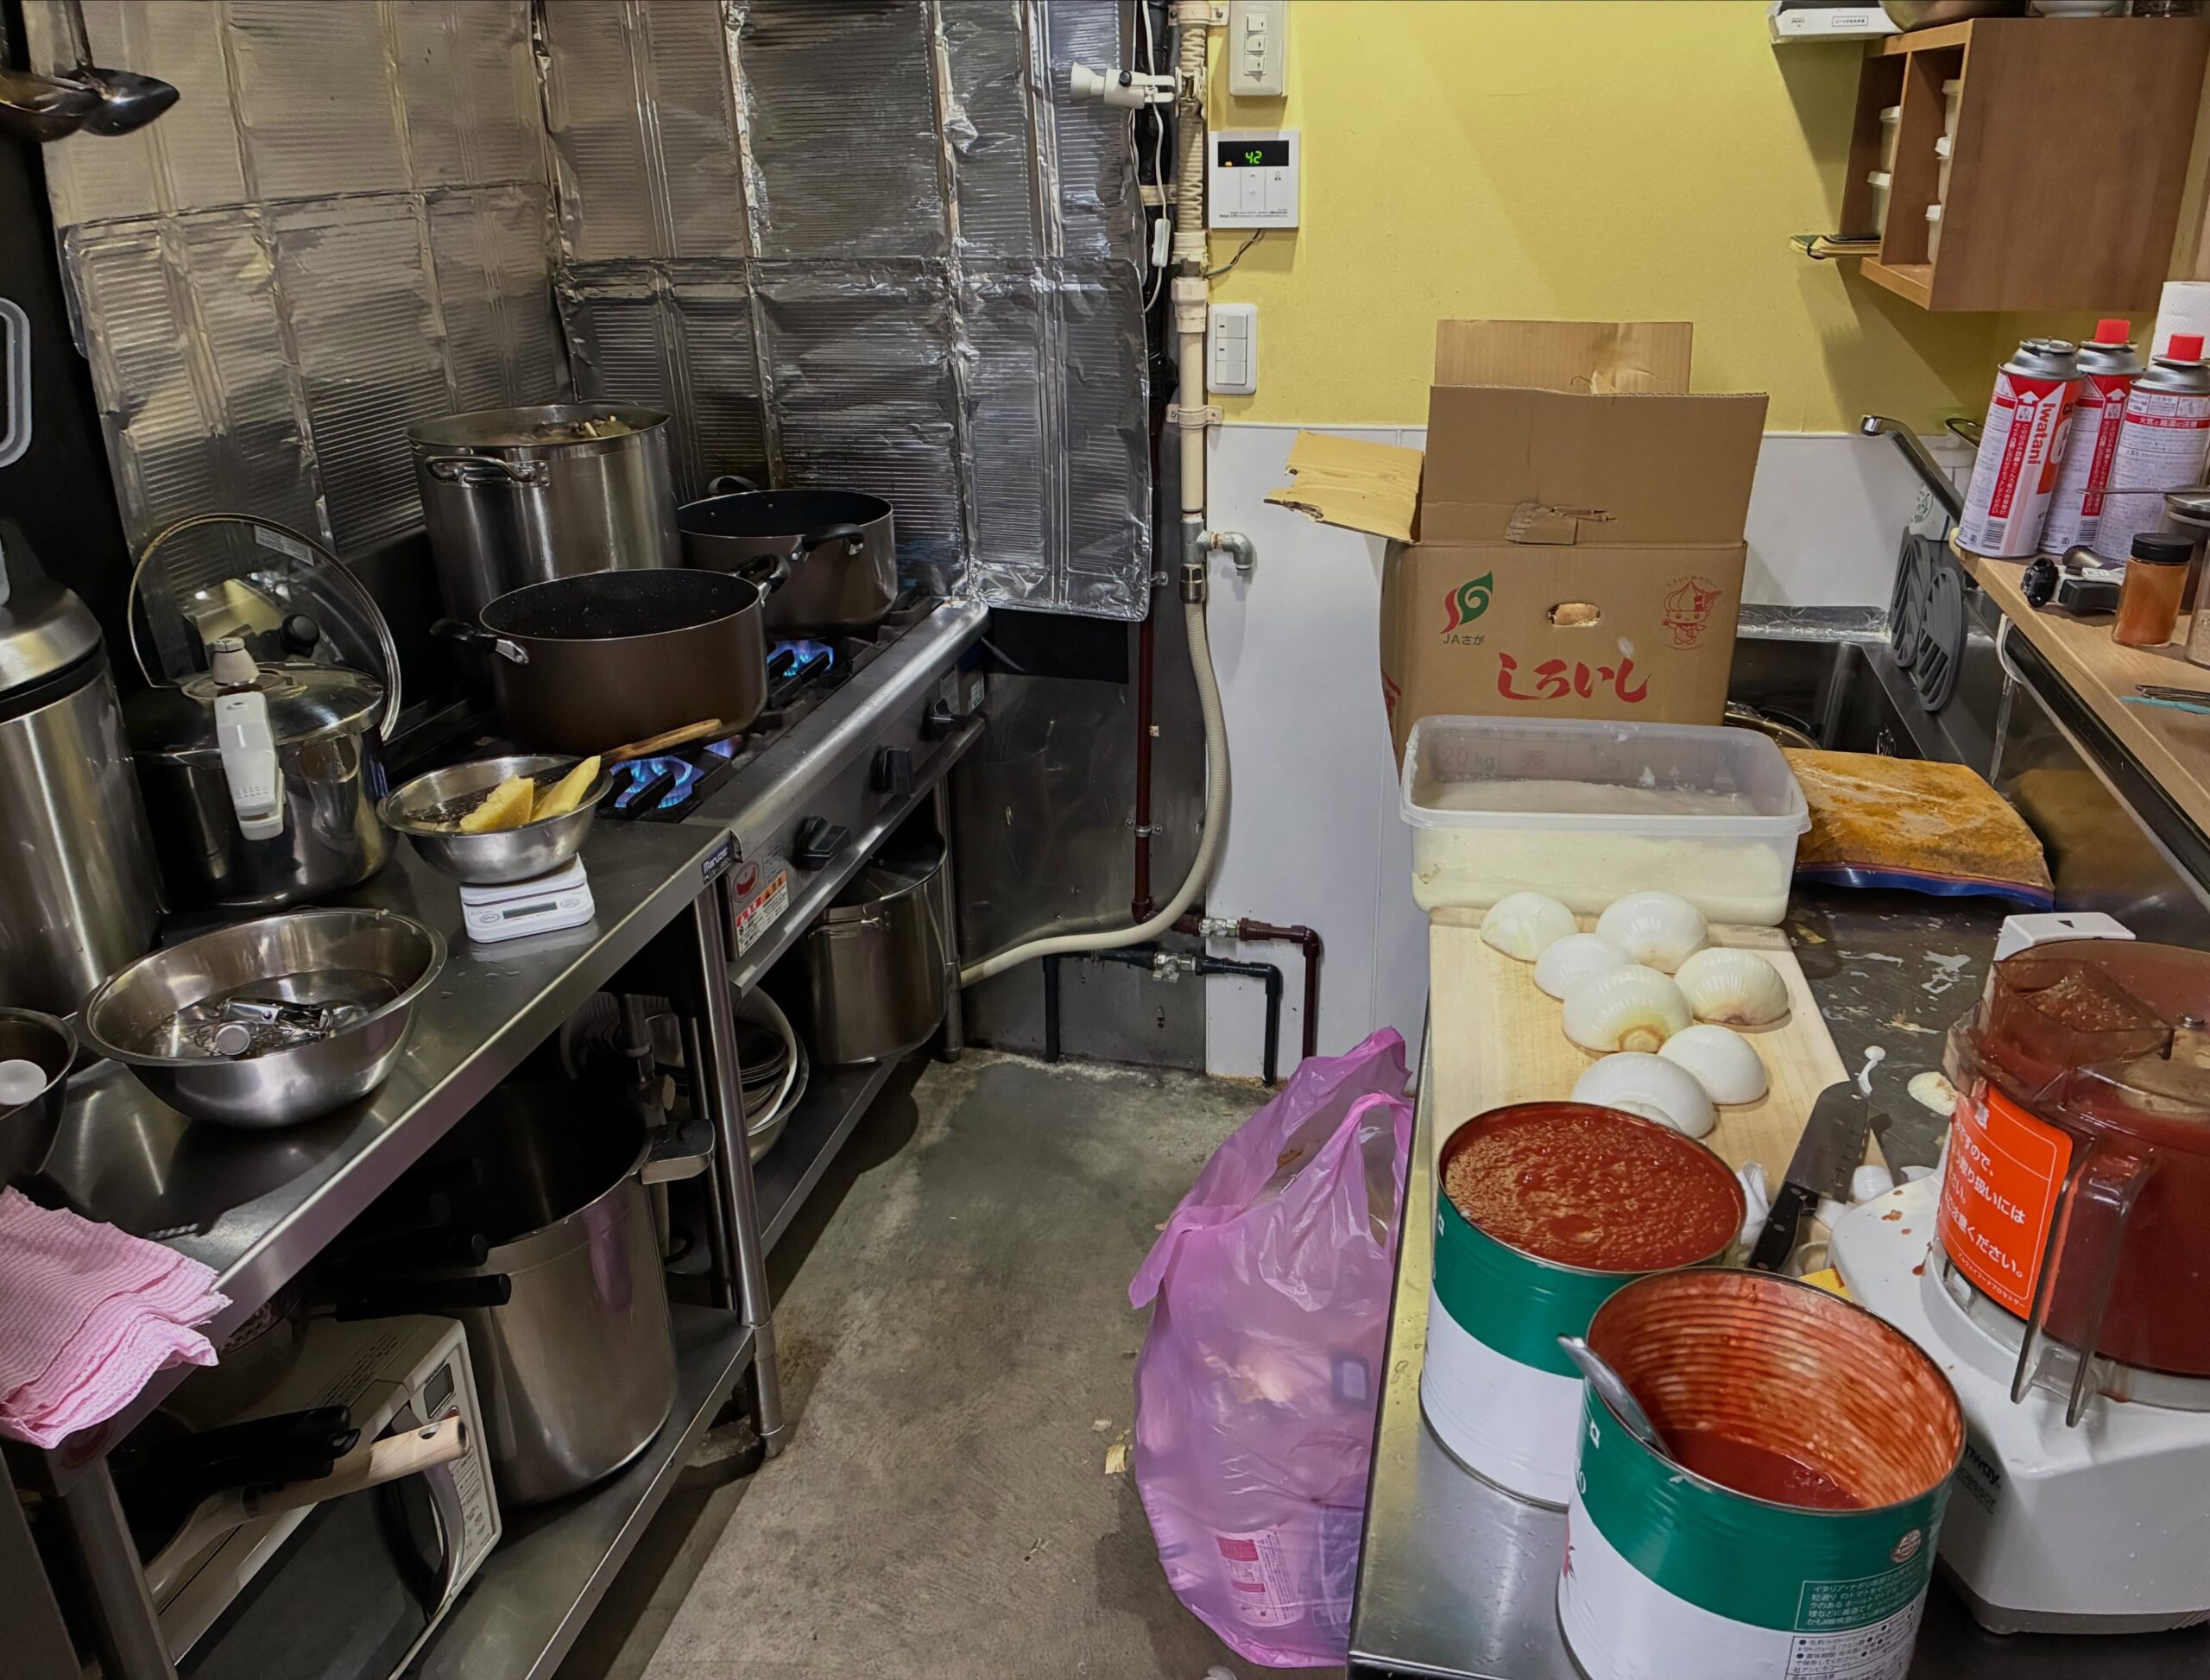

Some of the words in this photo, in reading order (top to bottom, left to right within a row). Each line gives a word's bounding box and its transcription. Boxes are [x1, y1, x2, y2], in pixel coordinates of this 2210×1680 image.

[1245, 150, 1263, 164] 42
[2027, 402, 2057, 465] Iwatani
[1443, 633, 1485, 647] JAさが
[1498, 652, 1653, 704] しろいし
[1965, 1442, 1999, 1486] mway
